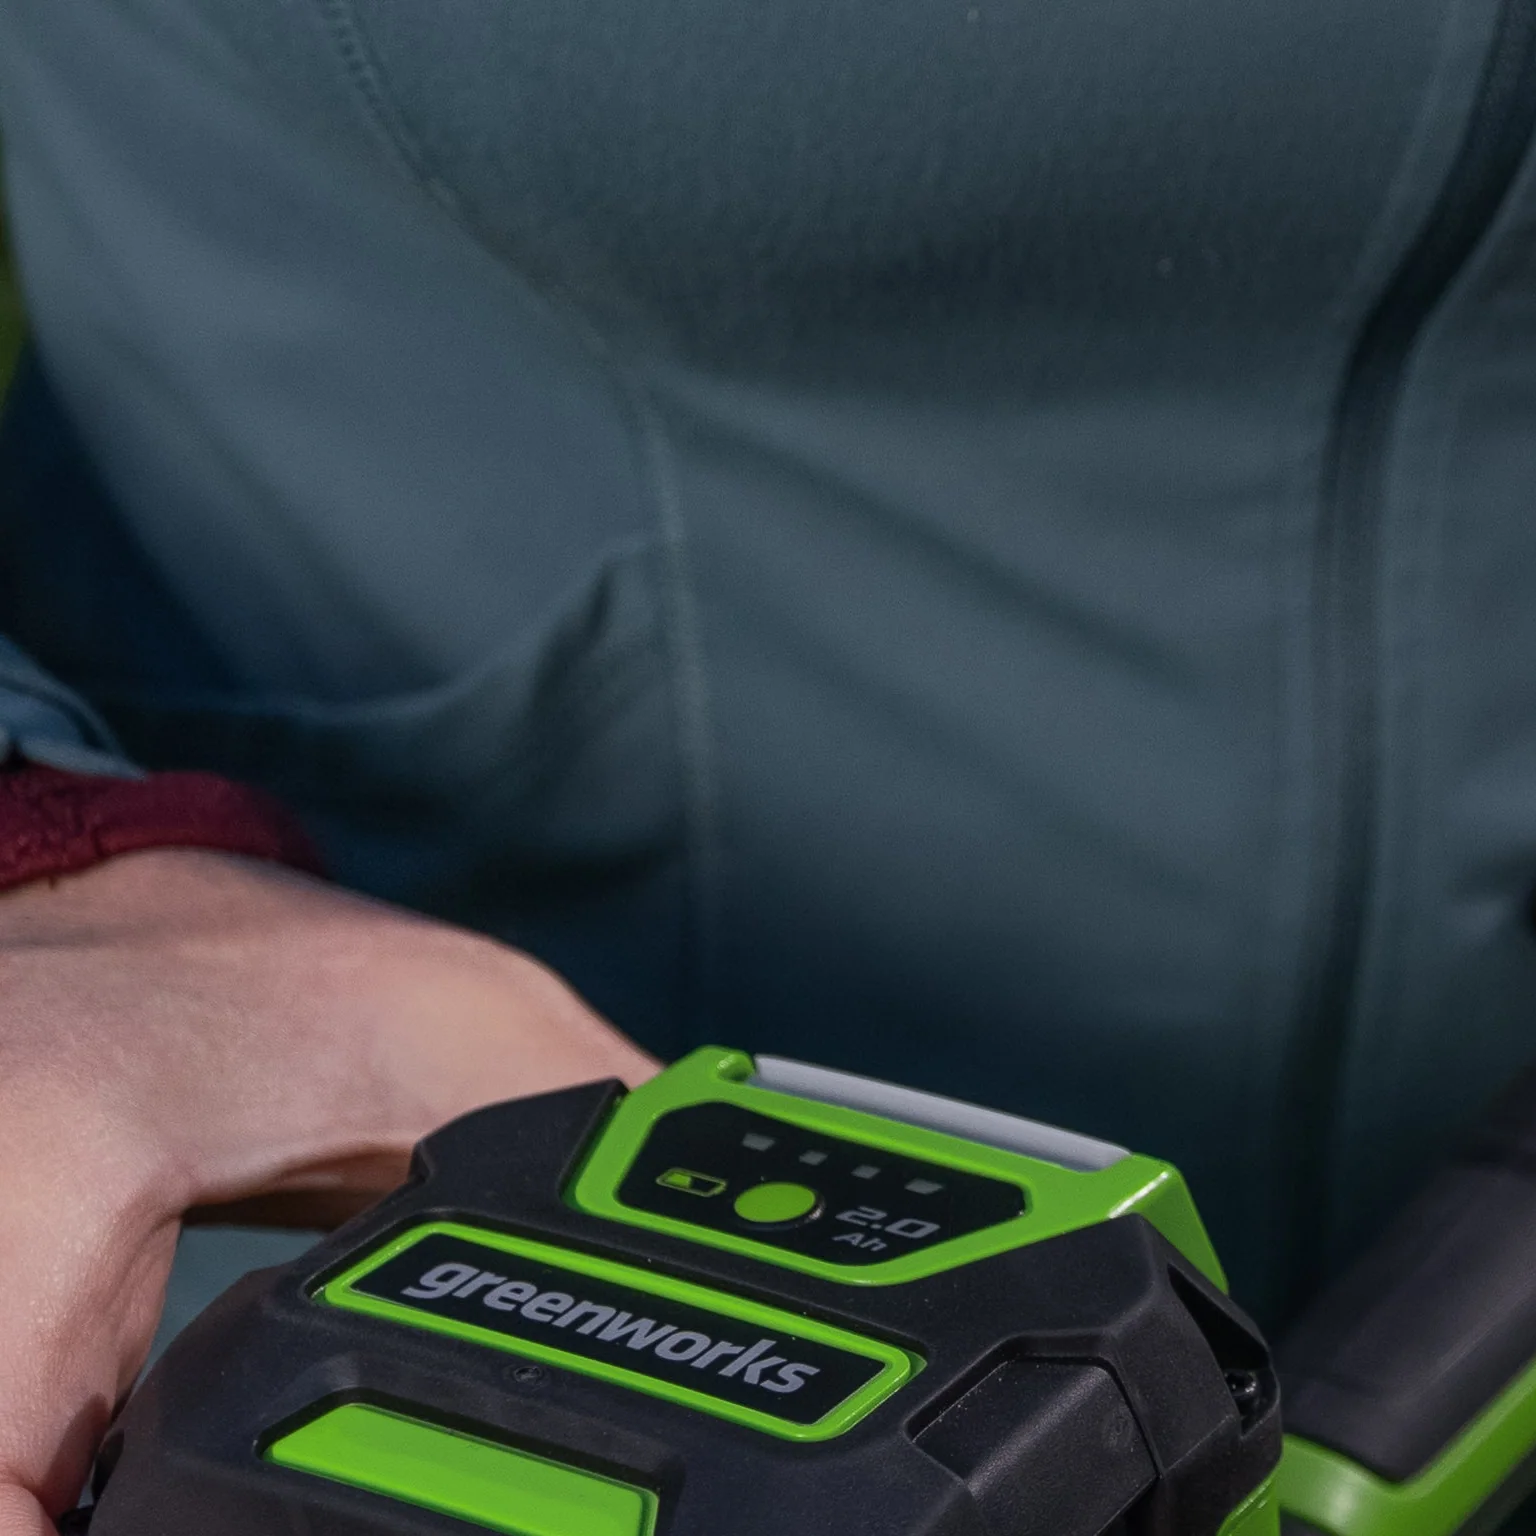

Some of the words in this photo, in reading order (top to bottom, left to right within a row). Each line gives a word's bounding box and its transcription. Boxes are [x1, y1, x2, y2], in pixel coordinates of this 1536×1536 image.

[835, 1206, 940, 1238] 2.0
[832, 1233, 887, 1252] Ah
[402, 1263, 820, 1393] greenworks
